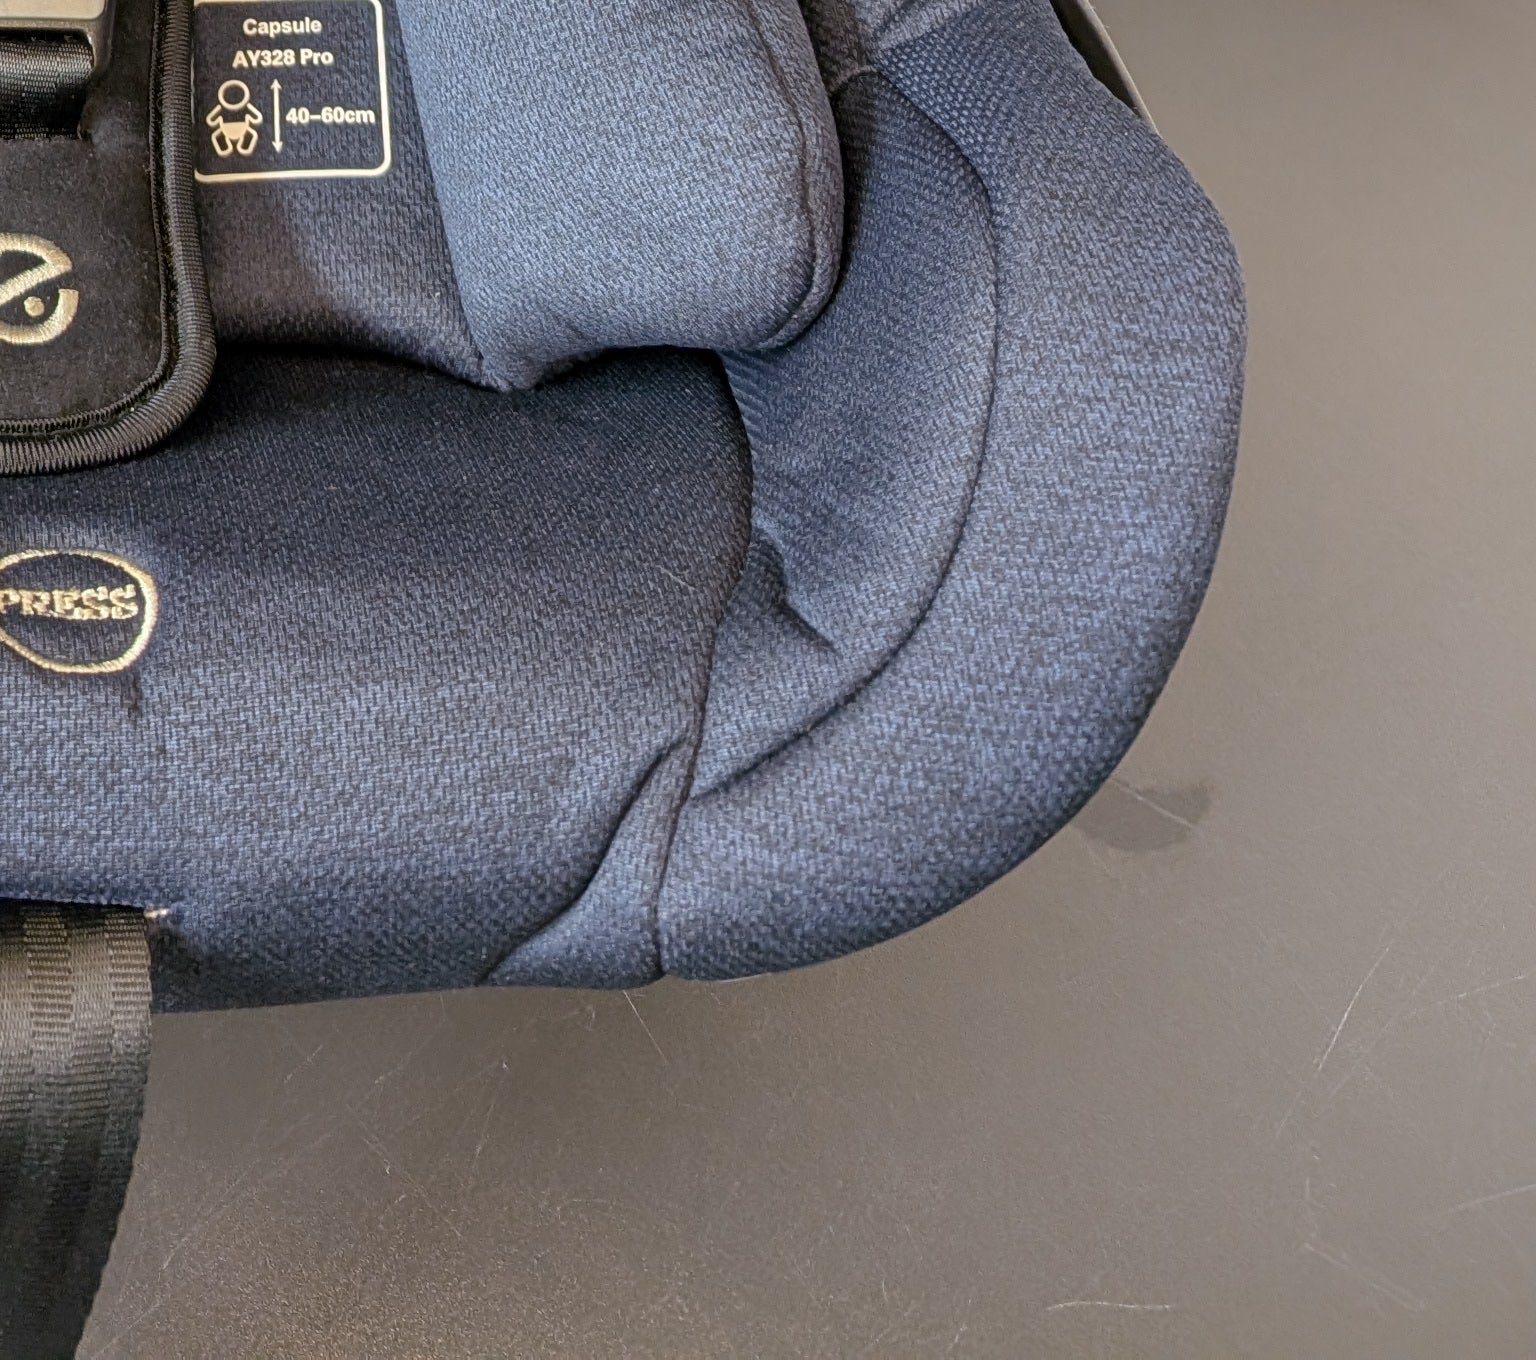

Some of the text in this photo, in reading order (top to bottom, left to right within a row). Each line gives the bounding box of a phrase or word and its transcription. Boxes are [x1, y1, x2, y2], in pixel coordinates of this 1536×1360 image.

[242, 17, 322, 38] Capsule
[232, 48, 335, 68] AY328 Pro
